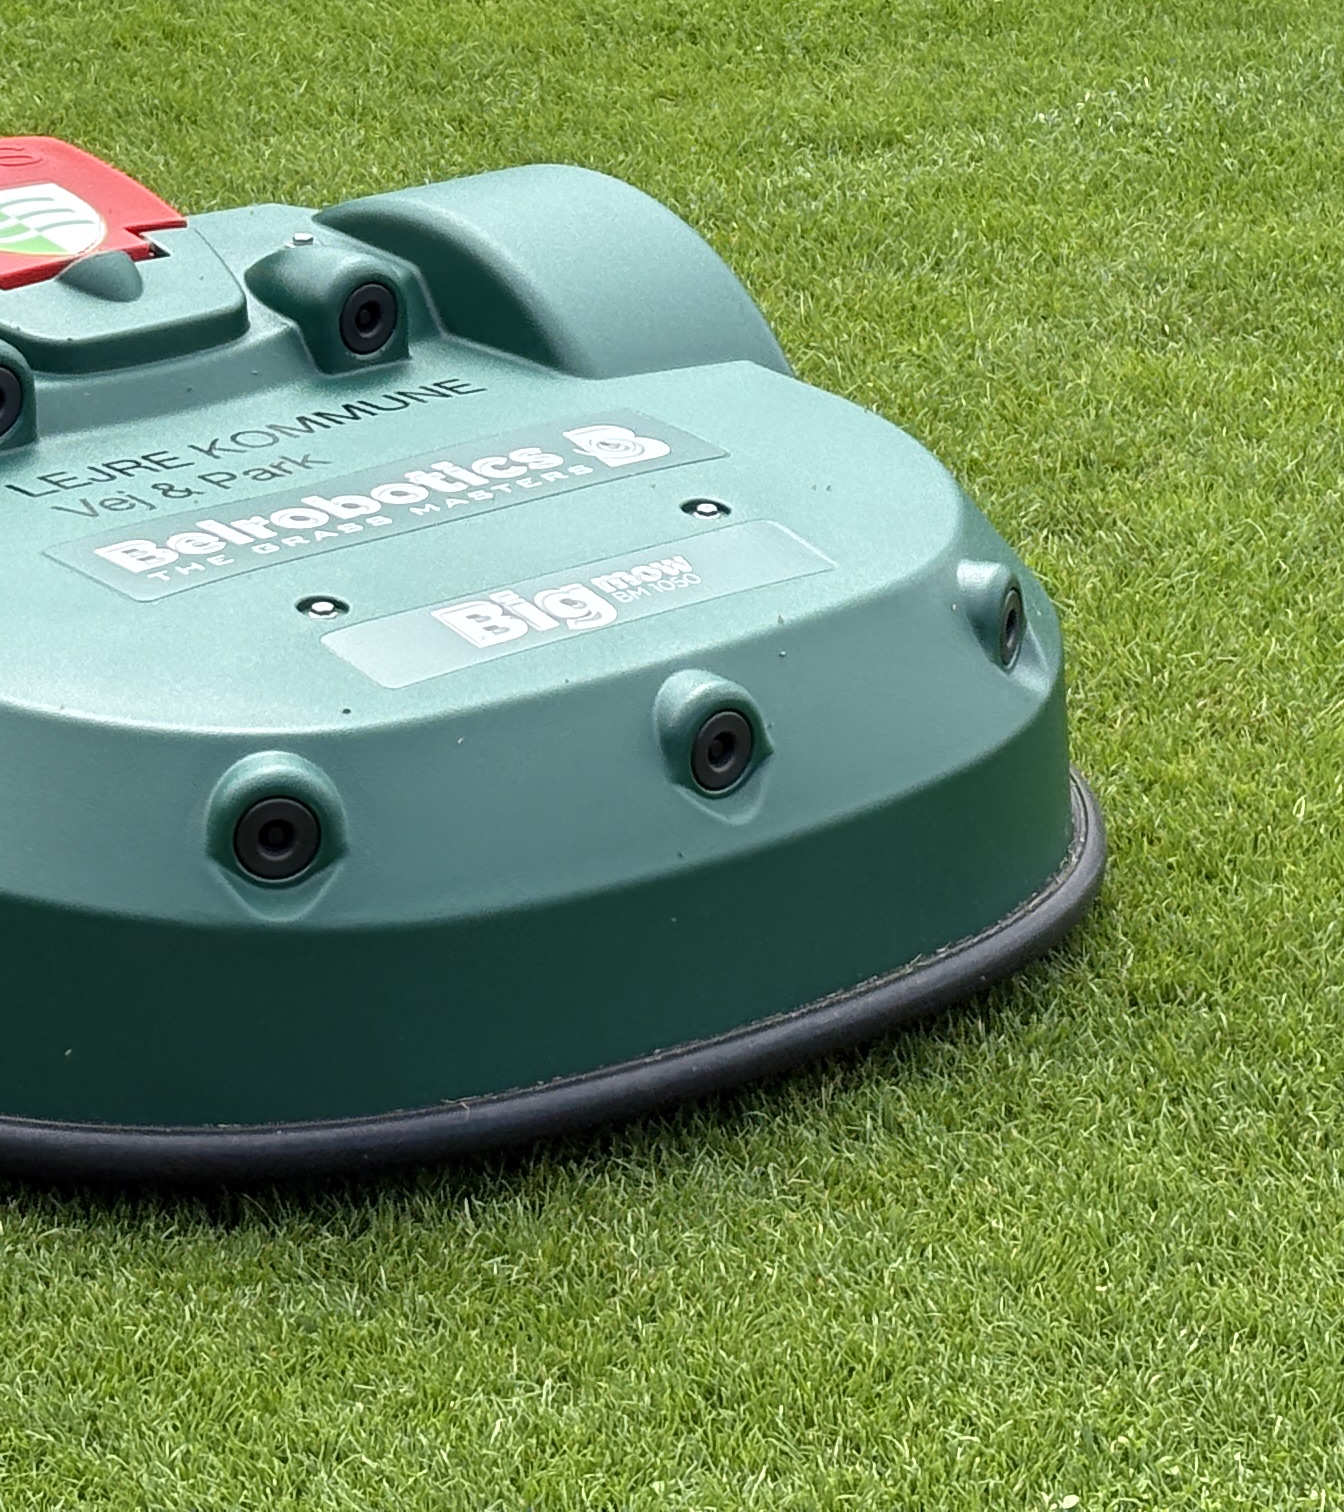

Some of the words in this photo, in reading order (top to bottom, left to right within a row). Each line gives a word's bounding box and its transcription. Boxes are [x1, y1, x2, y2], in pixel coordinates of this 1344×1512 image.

[5, 450, 196, 498] LEJRE
[188, 378, 487, 460] KOMMUNE
[52, 491, 157, 519] Vej
[151, 481, 203, 500] &
[198, 452, 330, 490] Park
[94, 447, 565, 574] Belrobotics
[147, 554, 235, 582] THE
[252, 515, 394, 555] GRASS
[409, 464, 595, 517] MASTERS
[431, 582, 619, 649] Big
[590, 554, 694, 594] mow
[611, 585, 652, 604] BM
